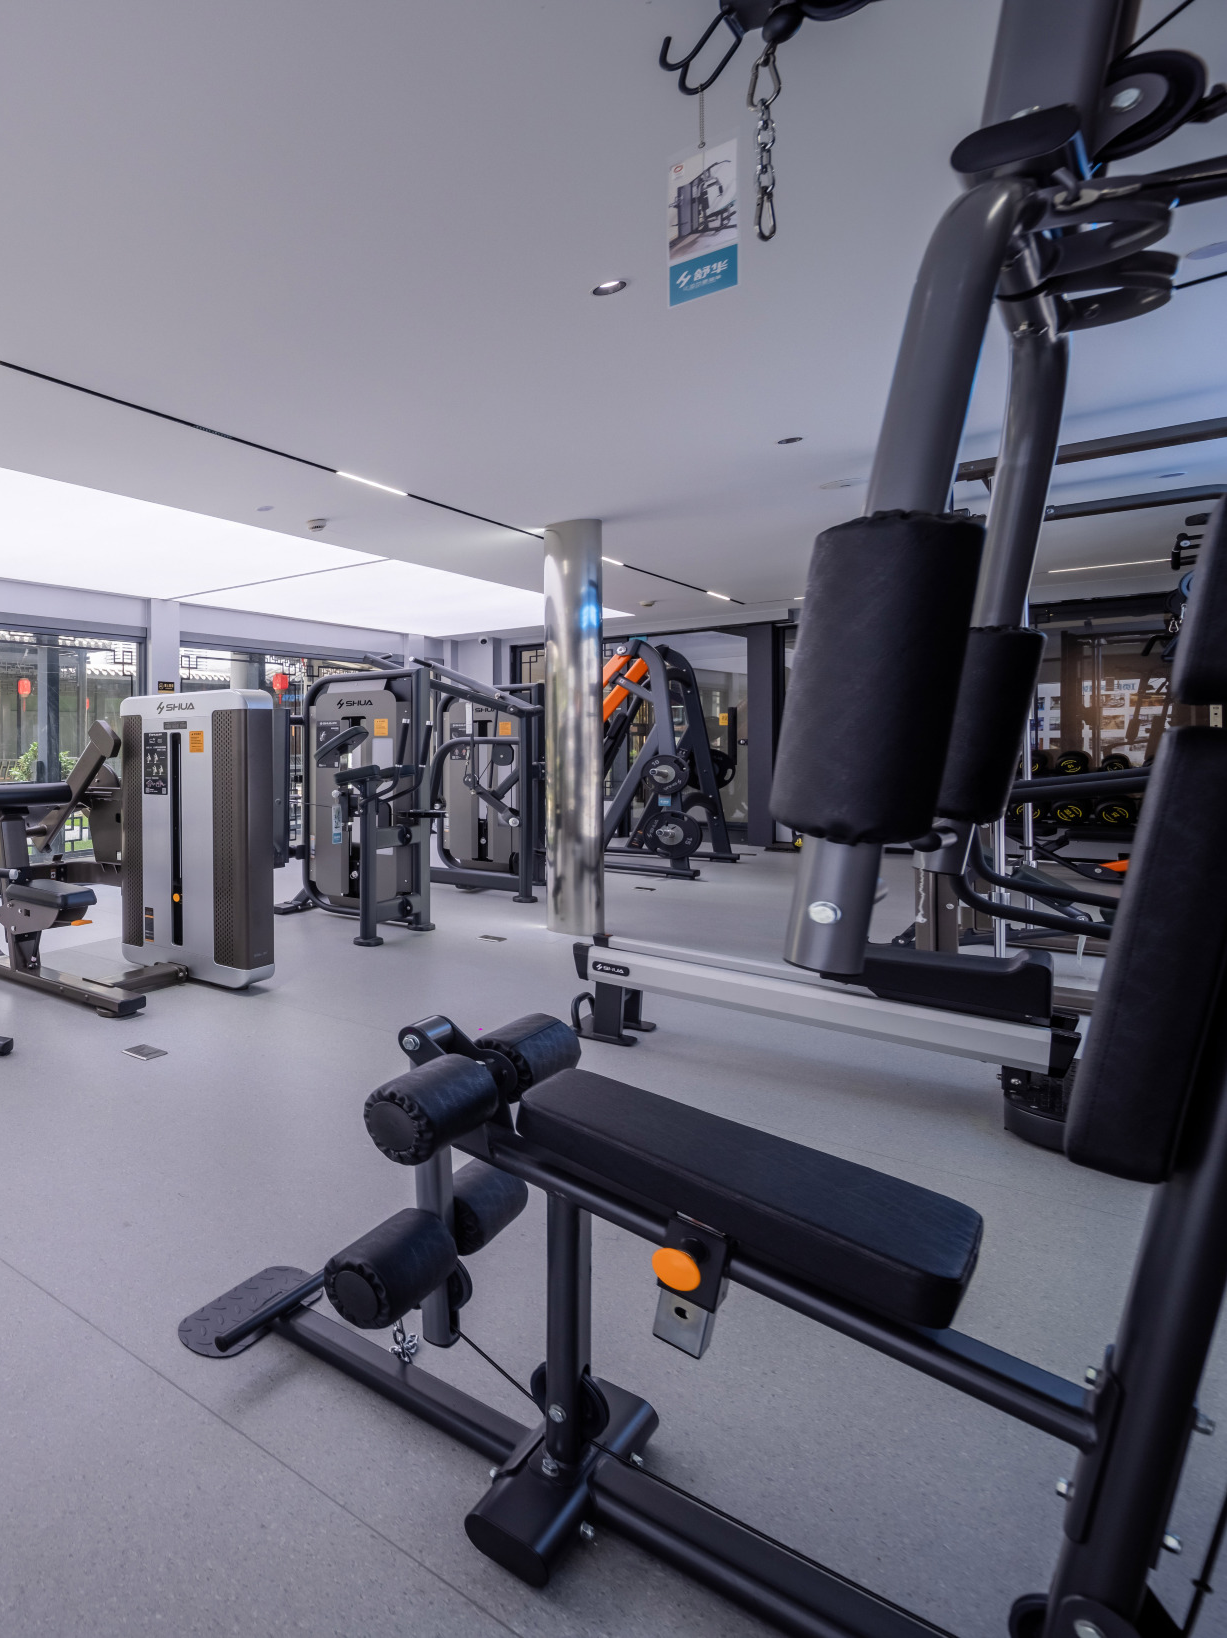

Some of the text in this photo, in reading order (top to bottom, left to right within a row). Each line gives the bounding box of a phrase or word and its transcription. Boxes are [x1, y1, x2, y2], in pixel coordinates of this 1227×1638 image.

[693, 259, 729, 281] 舒华
[165, 702, 195, 712] SHUA
[345, 699, 373, 707] SHUA
